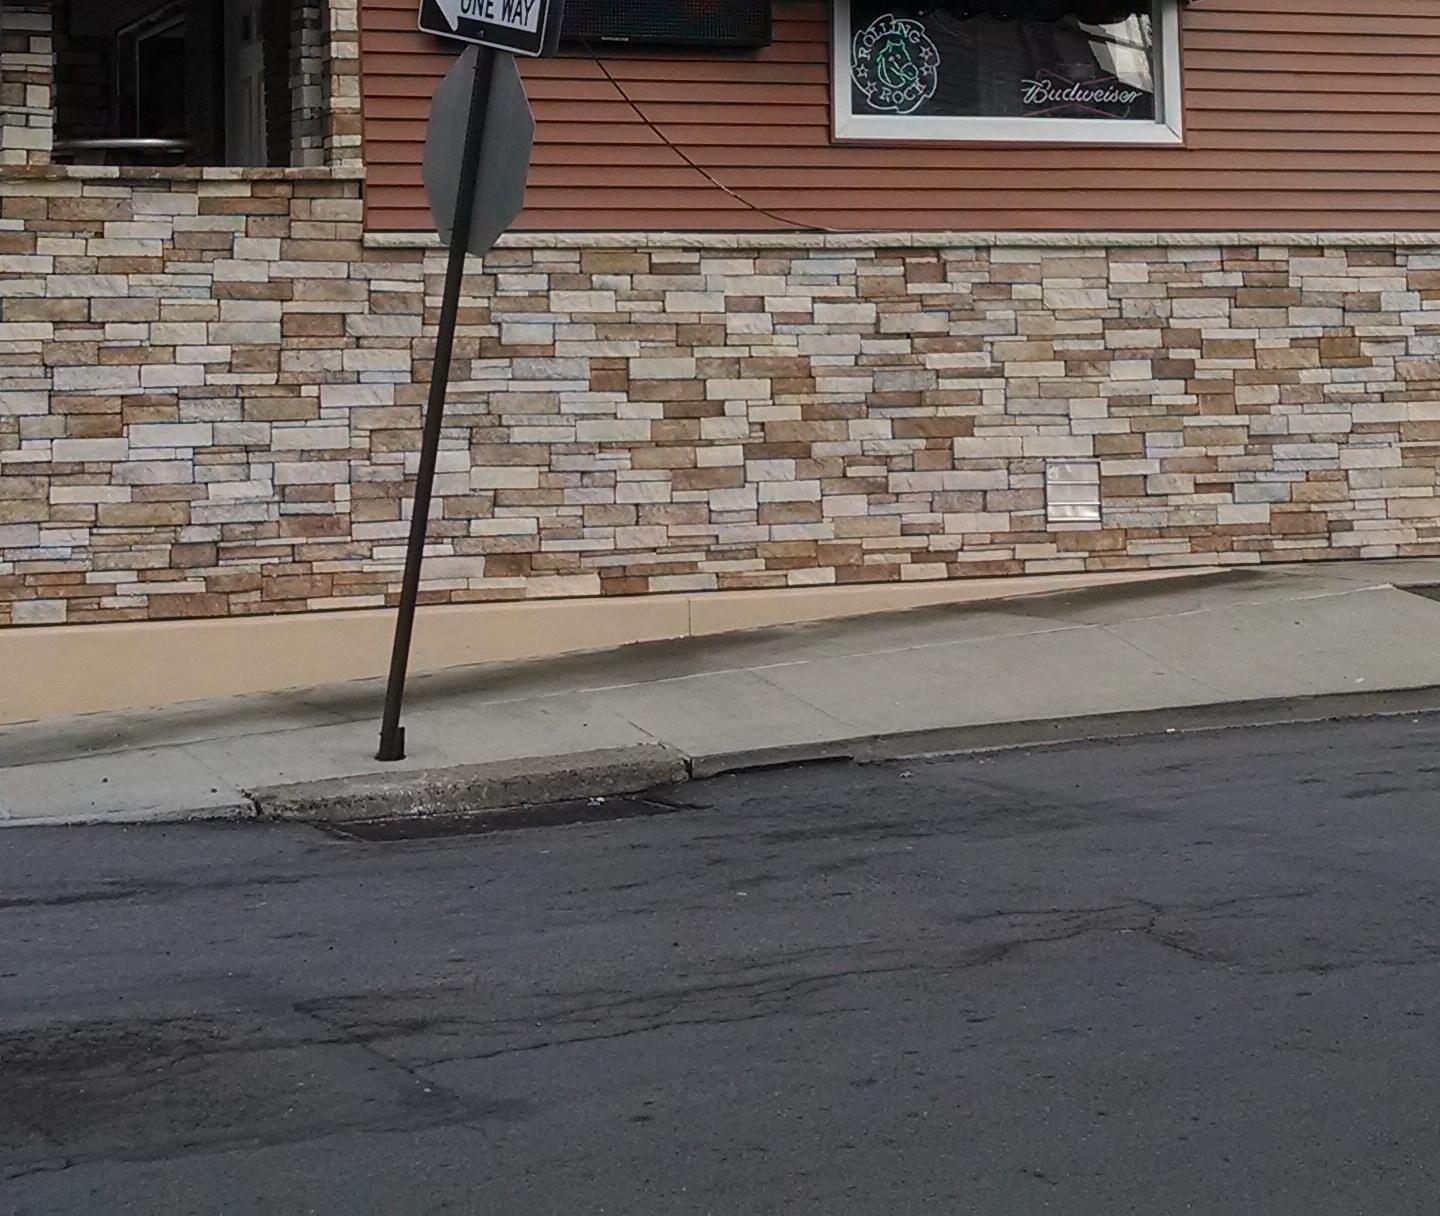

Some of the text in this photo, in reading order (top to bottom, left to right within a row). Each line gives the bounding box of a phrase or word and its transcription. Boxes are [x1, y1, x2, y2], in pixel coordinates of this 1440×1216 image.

[858, 22, 921, 61] ROLLING
[879, 78, 927, 104] ROCK
[1020, 79, 1144, 104] Budweiser
